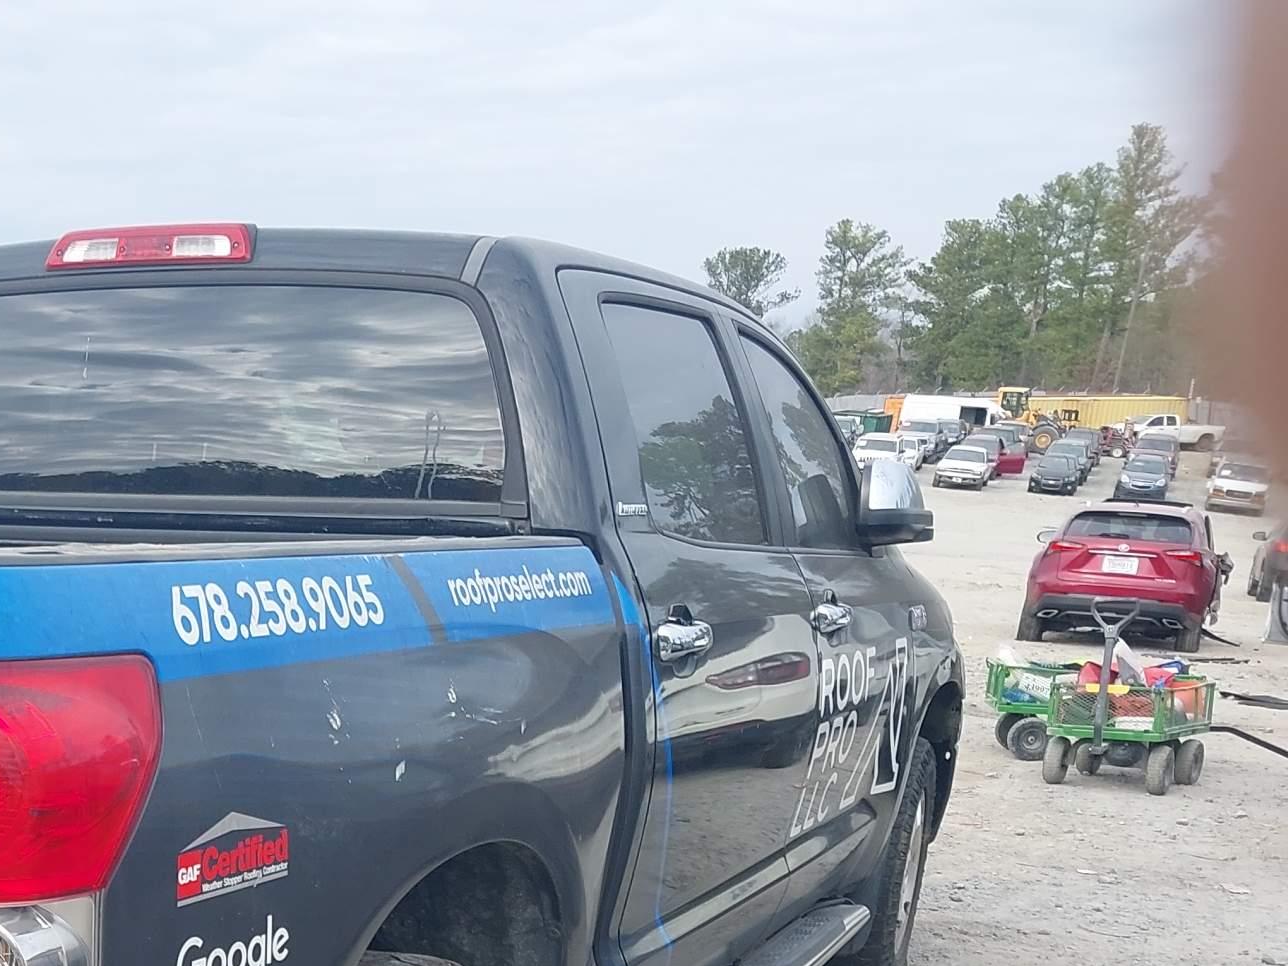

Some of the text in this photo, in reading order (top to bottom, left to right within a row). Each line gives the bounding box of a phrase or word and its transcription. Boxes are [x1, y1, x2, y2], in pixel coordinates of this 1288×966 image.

[171, 574, 385, 646] 678.258.9065
[447, 565, 593, 614] roofproselect.com
[820, 646, 877, 718] ROOF
[807, 710, 858, 780] PRO
[789, 771, 839, 838] LLC
[178, 829, 289, 885] GAF Certified
